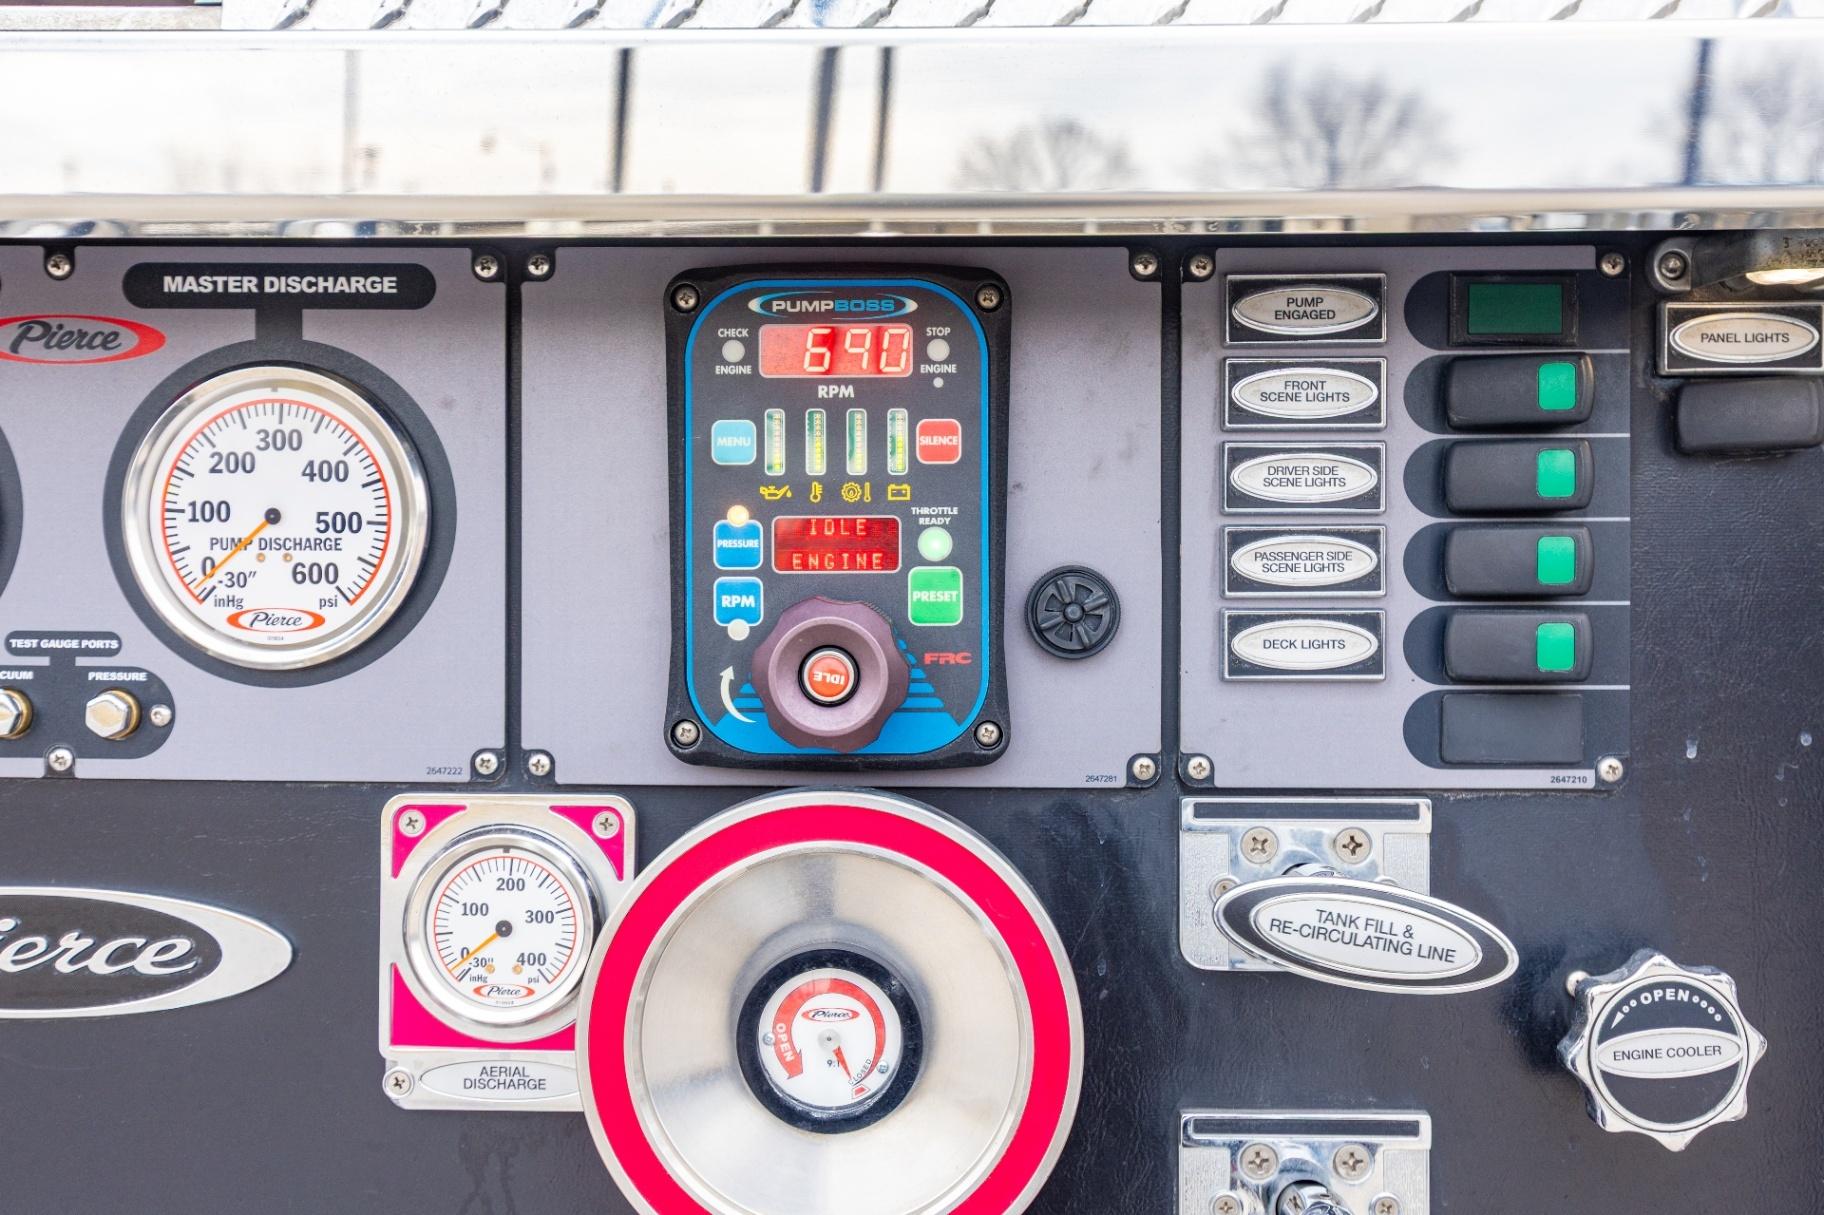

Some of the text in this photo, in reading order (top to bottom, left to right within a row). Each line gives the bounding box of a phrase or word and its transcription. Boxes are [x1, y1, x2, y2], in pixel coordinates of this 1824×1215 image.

[163, 276, 398, 293] MASTER DISCHARGE
[1286, 297, 1324, 307] PUMP
[1274, 310, 1336, 320] ENGAGED
[10, 319, 123, 354] Pierce
[717, 328, 749, 337] CHECK
[926, 327, 951, 336] STOP
[1701, 333, 1790, 343] PANEL LIGHTS
[803, 328, 910, 373] 690
[715, 365, 752, 374] ENGINE
[920, 364, 957, 373] ENGINE
[817, 385, 855, 398] RPM
[1284, 380, 1326, 391] FRONT
[1260, 391, 1350, 402] SCENE LIGHTS
[256, 429, 303, 451] 300
[717, 435, 751, 447] MENU
[919, 435, 958, 445] SILENCE
[209, 452, 256, 475] 200
[302, 460, 349, 483] 400
[1267, 466, 1338, 476] DRIVER SIDE
[1263, 478, 1346, 487] SCENE LIGHTS
[187, 501, 231, 523] 100
[911, 507, 958, 515] THROTTLE
[315, 511, 363, 534] 500
[810, 519, 867, 535] IDLE
[919, 517, 951, 525] READY
[210, 537, 342, 551] PUMP DISCHARGE
[717, 539, 759, 548] PRESSURE
[793, 553, 883, 570] ENGINE
[1254, 551, 1353, 562] PASSENGER SIDE
[201, 556, 216, 578] 0
[1262, 563, 1345, 573] SCENE LIGHTS
[292, 562, 339, 585] 600
[214, 595, 244, 609] inHg
[319, 595, 338, 609] psi
[721, 596, 755, 608] RPM
[912, 591, 958, 602] PRESET
[250, 611, 302, 627] Pierce
[9, 639, 119, 649] TEST GAUGE PORTS
[1263, 639, 1345, 650] DECK LIGHTS
[924, 652, 972, 665] FRC
[88, 672, 147, 681] PRESSURE
[813, 670, 845, 685] IDLE
[1550, 776, 1588, 784] 2647210
[495, 878, 525, 891] 200
[461, 903, 489, 916] 100
[525, 910, 554, 924] 300
[1316, 909, 1414, 939] TANK FILL &
[1269, 918, 1456, 963] RE-CIRCULATING LINE
[460, 947, 469, 959] 0
[517, 952, 547, 966] 400
[487, 985, 520, 996] Pierce
[1640, 988, 1689, 1005] OPEN
[776, 1023, 795, 1062] OPEN
[1613, 1045, 1722, 1061] ENGINE COOLER
[480, 1067, 530, 1078] AERIAL
[463, 1079, 546, 1091] DISCHARGE
